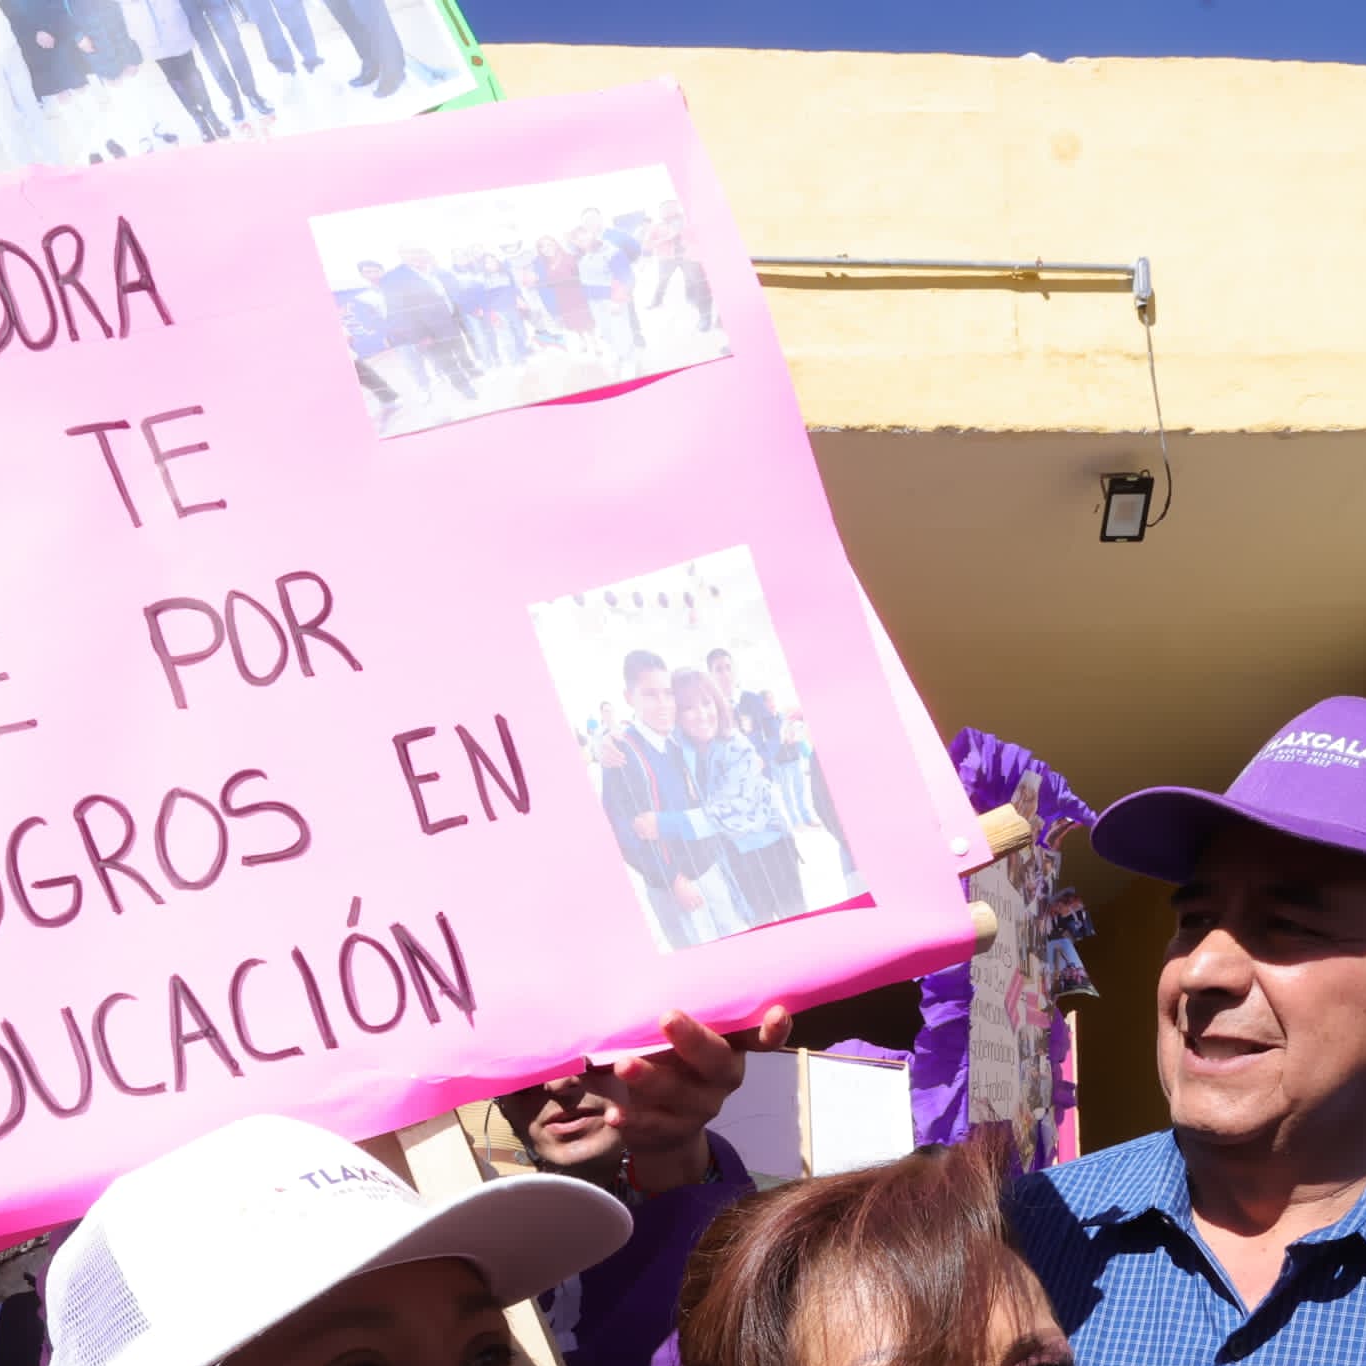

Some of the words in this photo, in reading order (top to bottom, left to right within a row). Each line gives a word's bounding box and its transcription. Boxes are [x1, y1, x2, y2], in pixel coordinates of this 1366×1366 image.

[66, 405, 227, 528] TE
[143, 570, 363, 709] POR
[392, 714, 531, 835] EN
